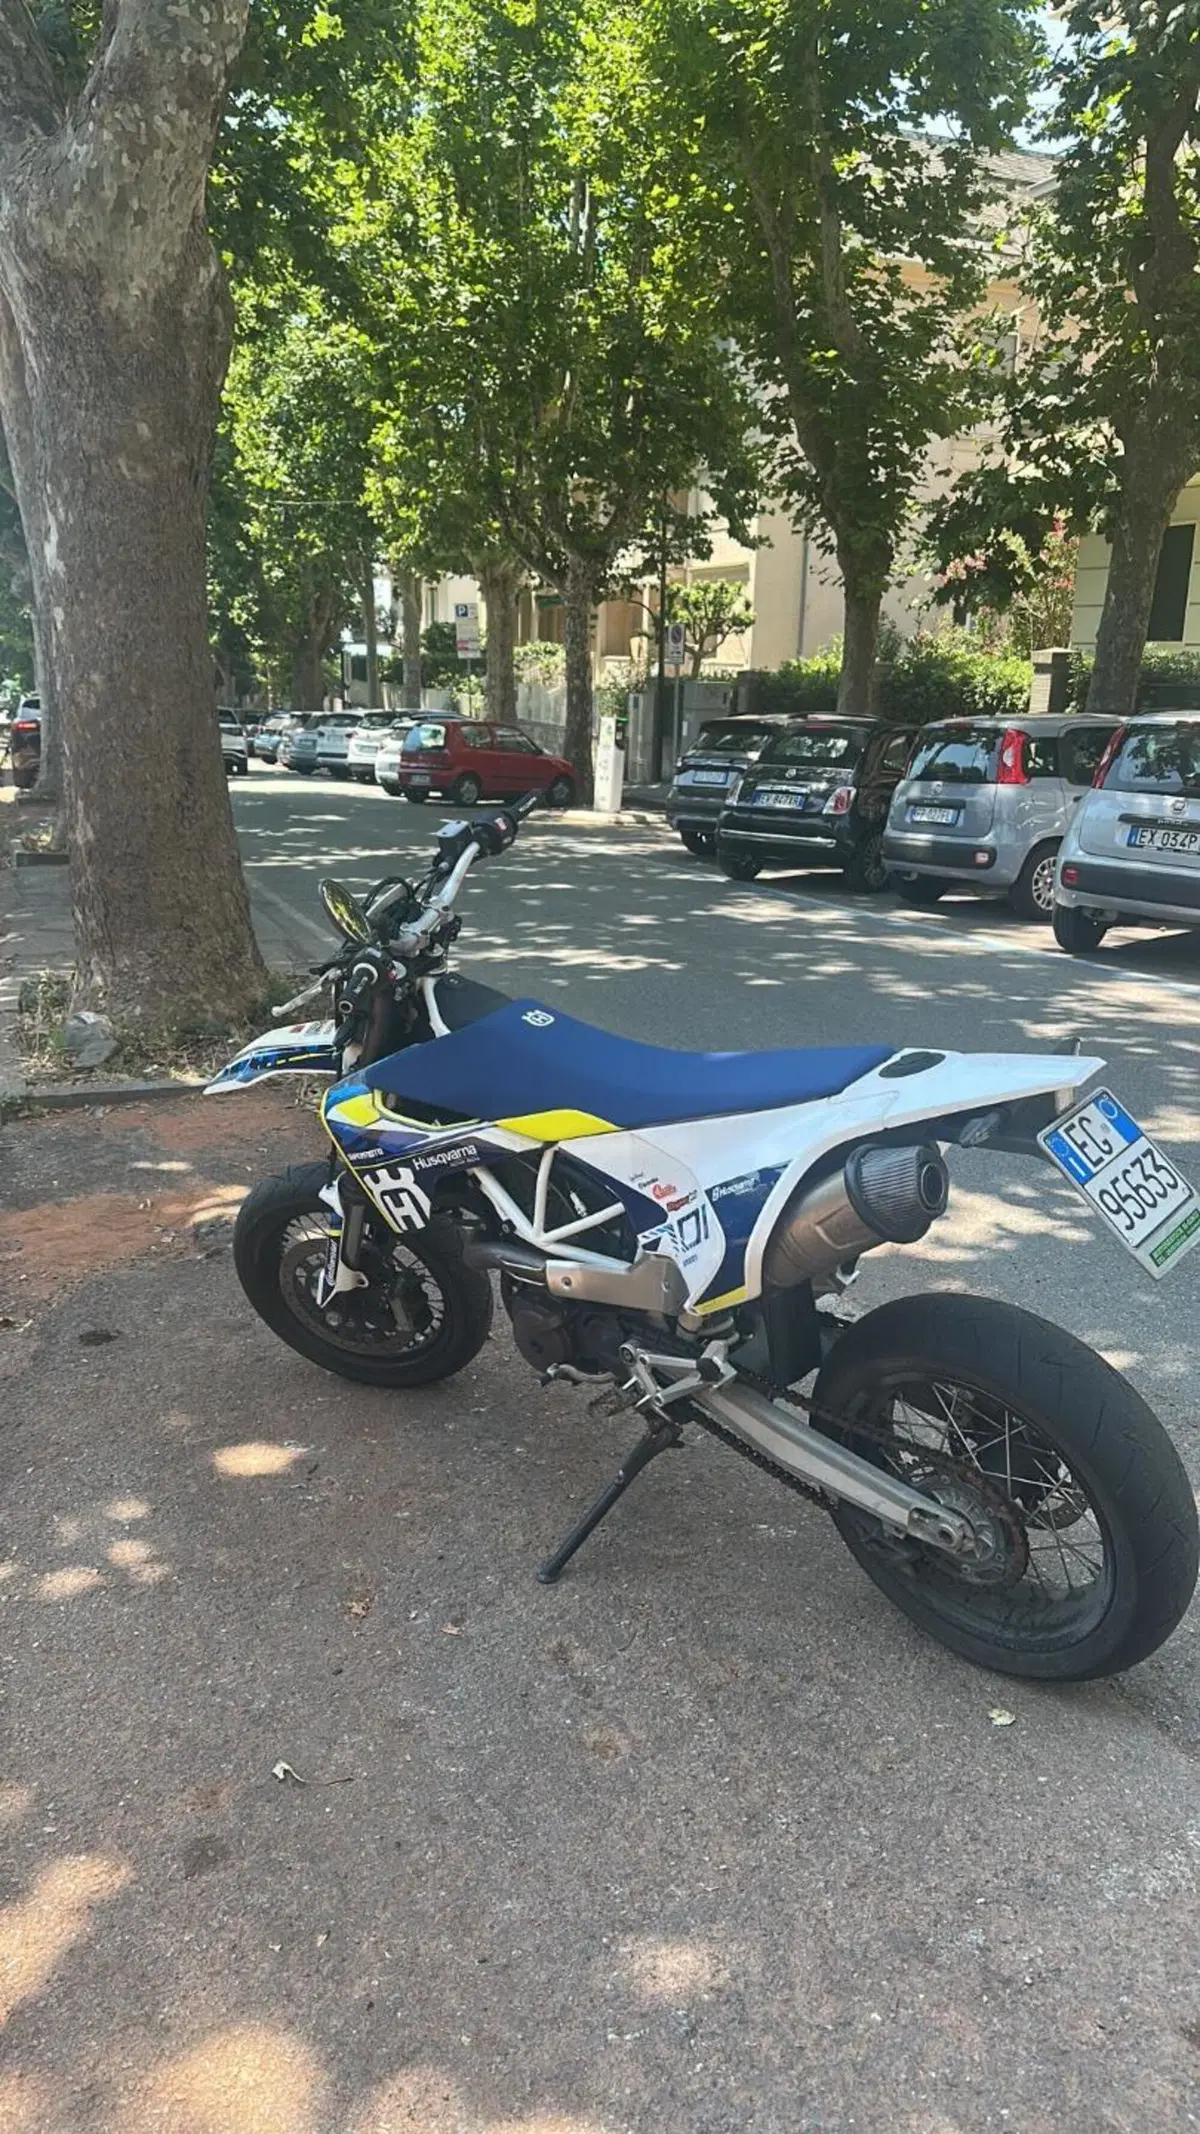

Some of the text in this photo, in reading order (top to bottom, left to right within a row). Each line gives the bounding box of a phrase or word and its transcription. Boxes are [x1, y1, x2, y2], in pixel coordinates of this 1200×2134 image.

[1138, 829, 1158, 845] EX
[411, 1144, 478, 1172] Husqvarna
[1063, 1115, 1114, 1169] EG
[1098, 1147, 1179, 1231] 95633
